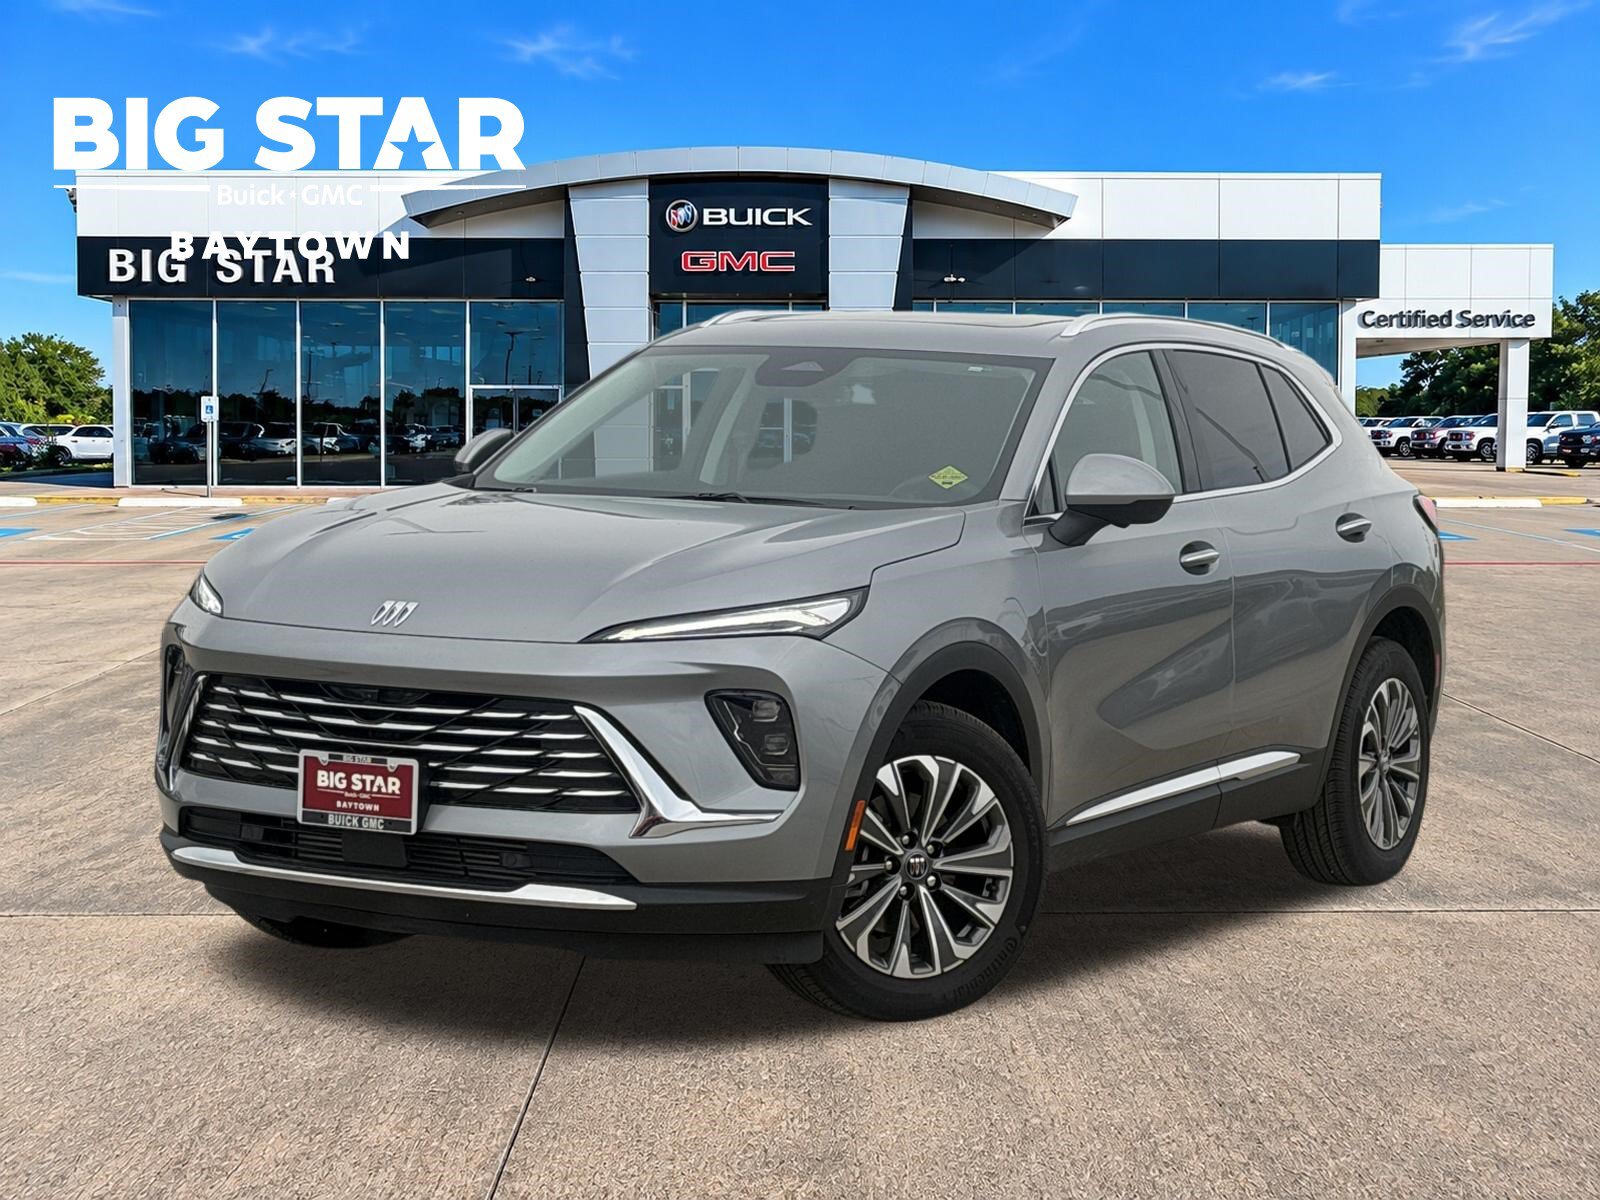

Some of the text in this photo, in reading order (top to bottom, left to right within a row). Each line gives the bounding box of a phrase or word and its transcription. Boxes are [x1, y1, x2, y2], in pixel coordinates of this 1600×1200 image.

[702, 207, 813, 226] BUICK
[108, 248, 335, 283] BIG STAR
[681, 250, 796, 272] GMC
[1360, 309, 1536, 329] Certified Service
[316, 770, 401, 794] BIG STAR
[336, 800, 380, 812] BAYTOWN
[328, 814, 385, 830] BUICK GMC
